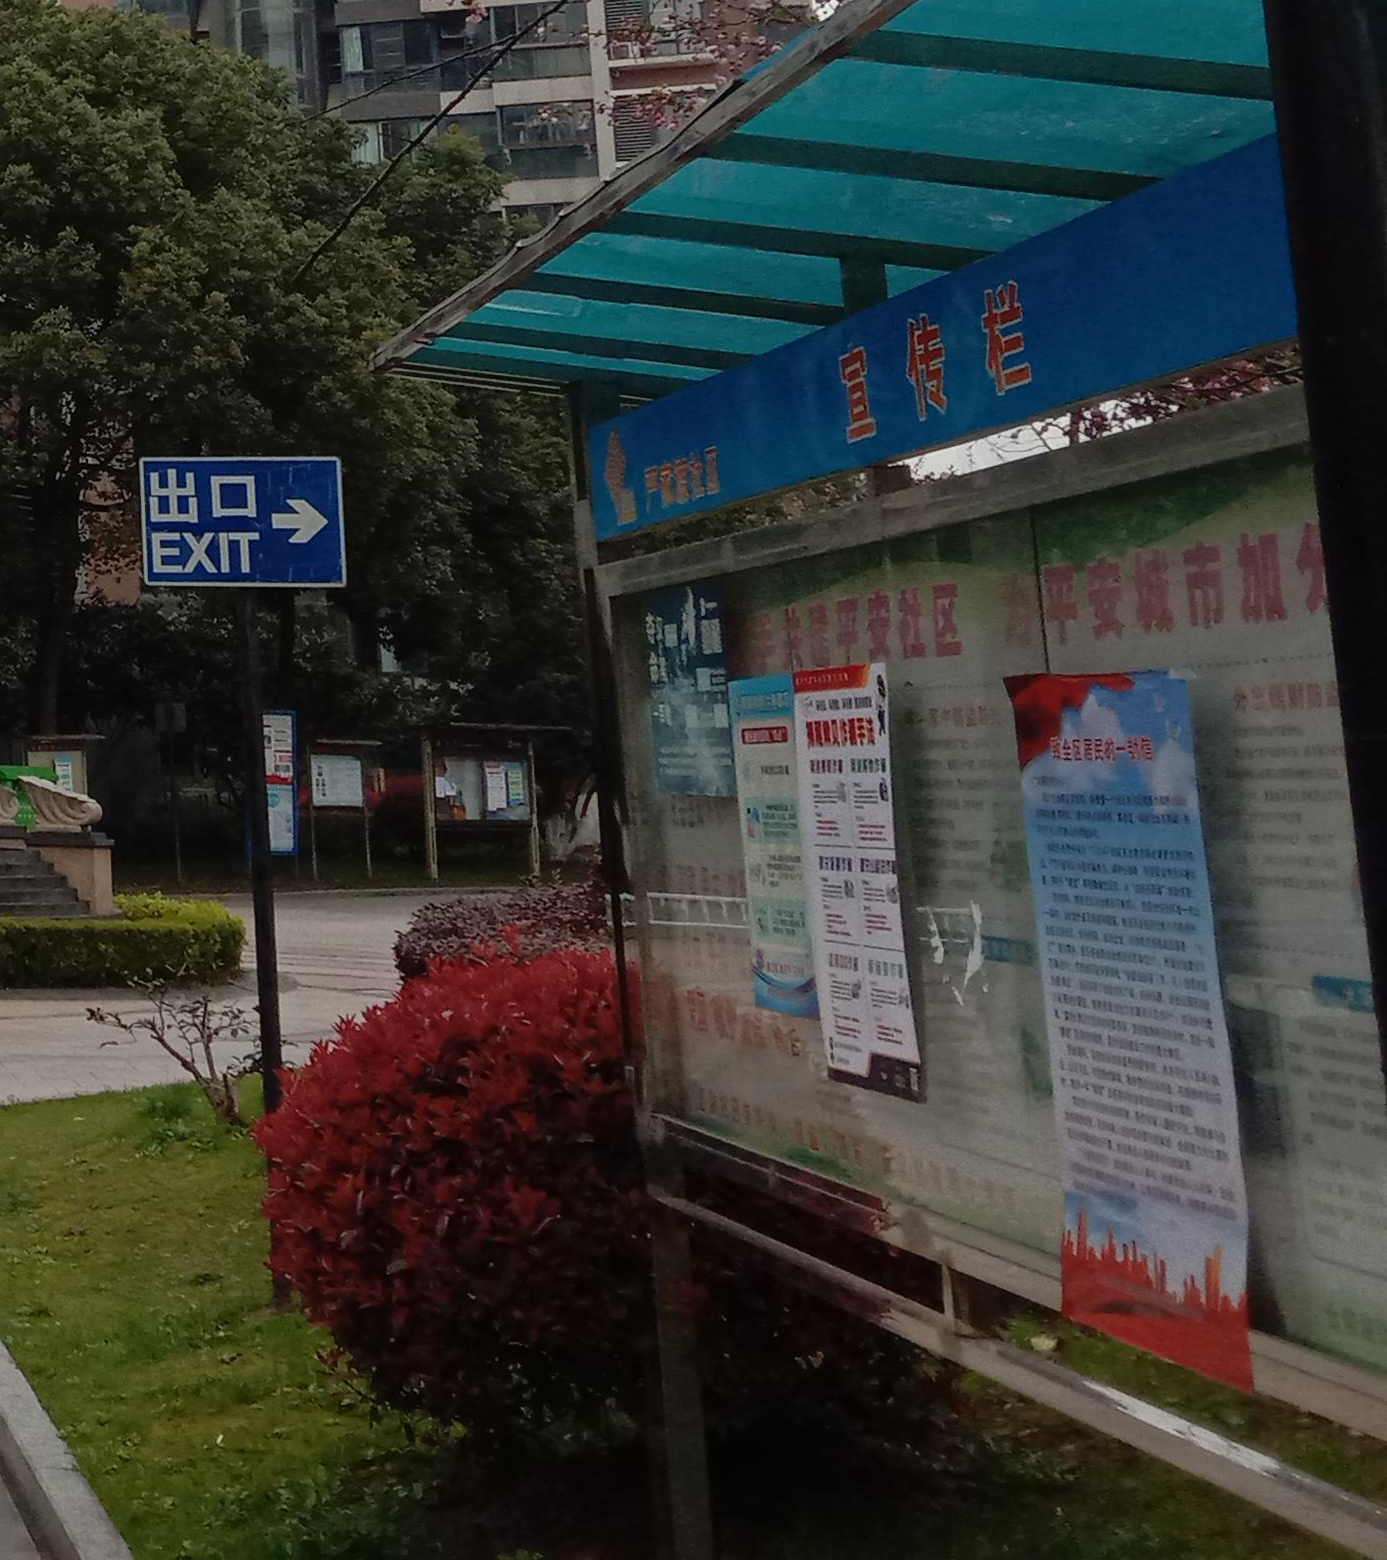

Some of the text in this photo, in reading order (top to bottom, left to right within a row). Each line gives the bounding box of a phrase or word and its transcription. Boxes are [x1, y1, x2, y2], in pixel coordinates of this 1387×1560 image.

[839, 279, 1032, 443] 宣传栏
[149, 467, 258, 524] 出口
[150, 531, 261, 574] EXIT
[1050, 736, 1154, 761] 致全区居民的一封信
